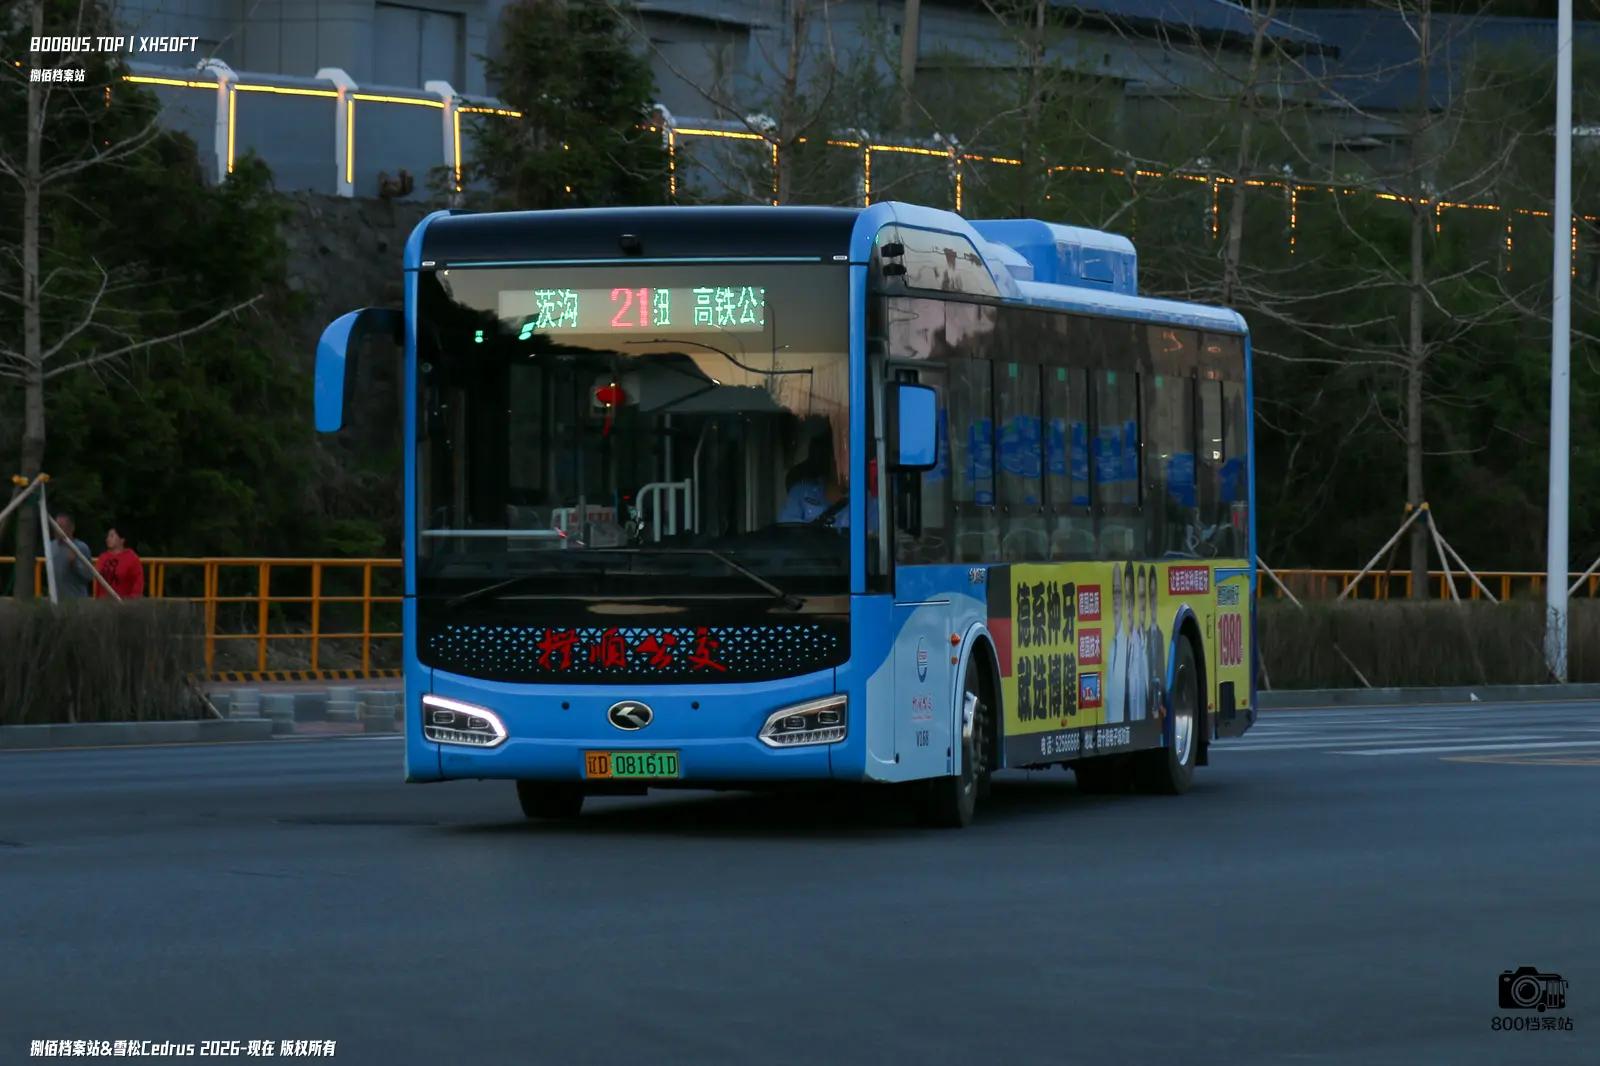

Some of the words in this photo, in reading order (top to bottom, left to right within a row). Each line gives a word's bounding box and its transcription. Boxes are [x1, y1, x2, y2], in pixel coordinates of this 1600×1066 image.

[535, 289, 578, 328] 茨沟
[611, 287, 649, 327] 21
[693, 286, 765, 326] 高铁公
[1217, 613, 1242, 666] 1980
